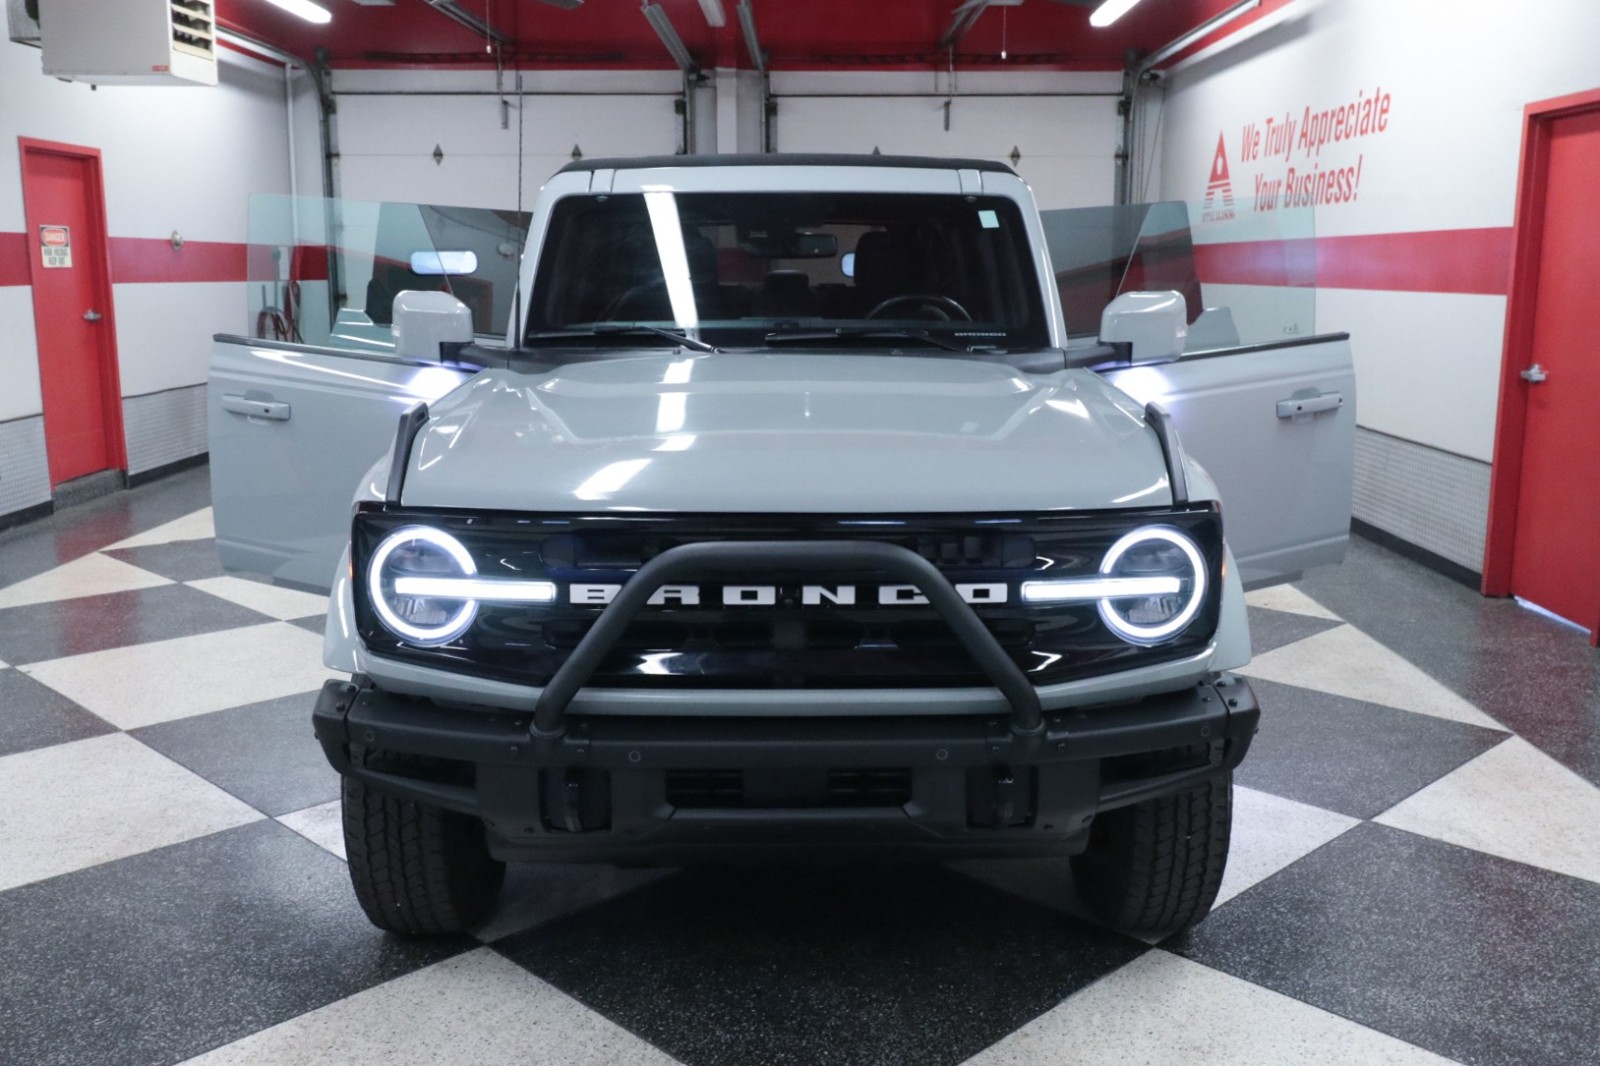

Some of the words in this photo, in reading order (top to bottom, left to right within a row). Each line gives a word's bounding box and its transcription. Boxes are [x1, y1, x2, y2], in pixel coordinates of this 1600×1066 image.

[1241, 123, 1261, 163] We
[1264, 112, 1297, 163] Truly
[1297, 86, 1391, 159] Appreciate
[1253, 173, 1282, 213] Your
[1283, 154, 1363, 208] Business!
[569, 583, 1008, 605] BRONCO
